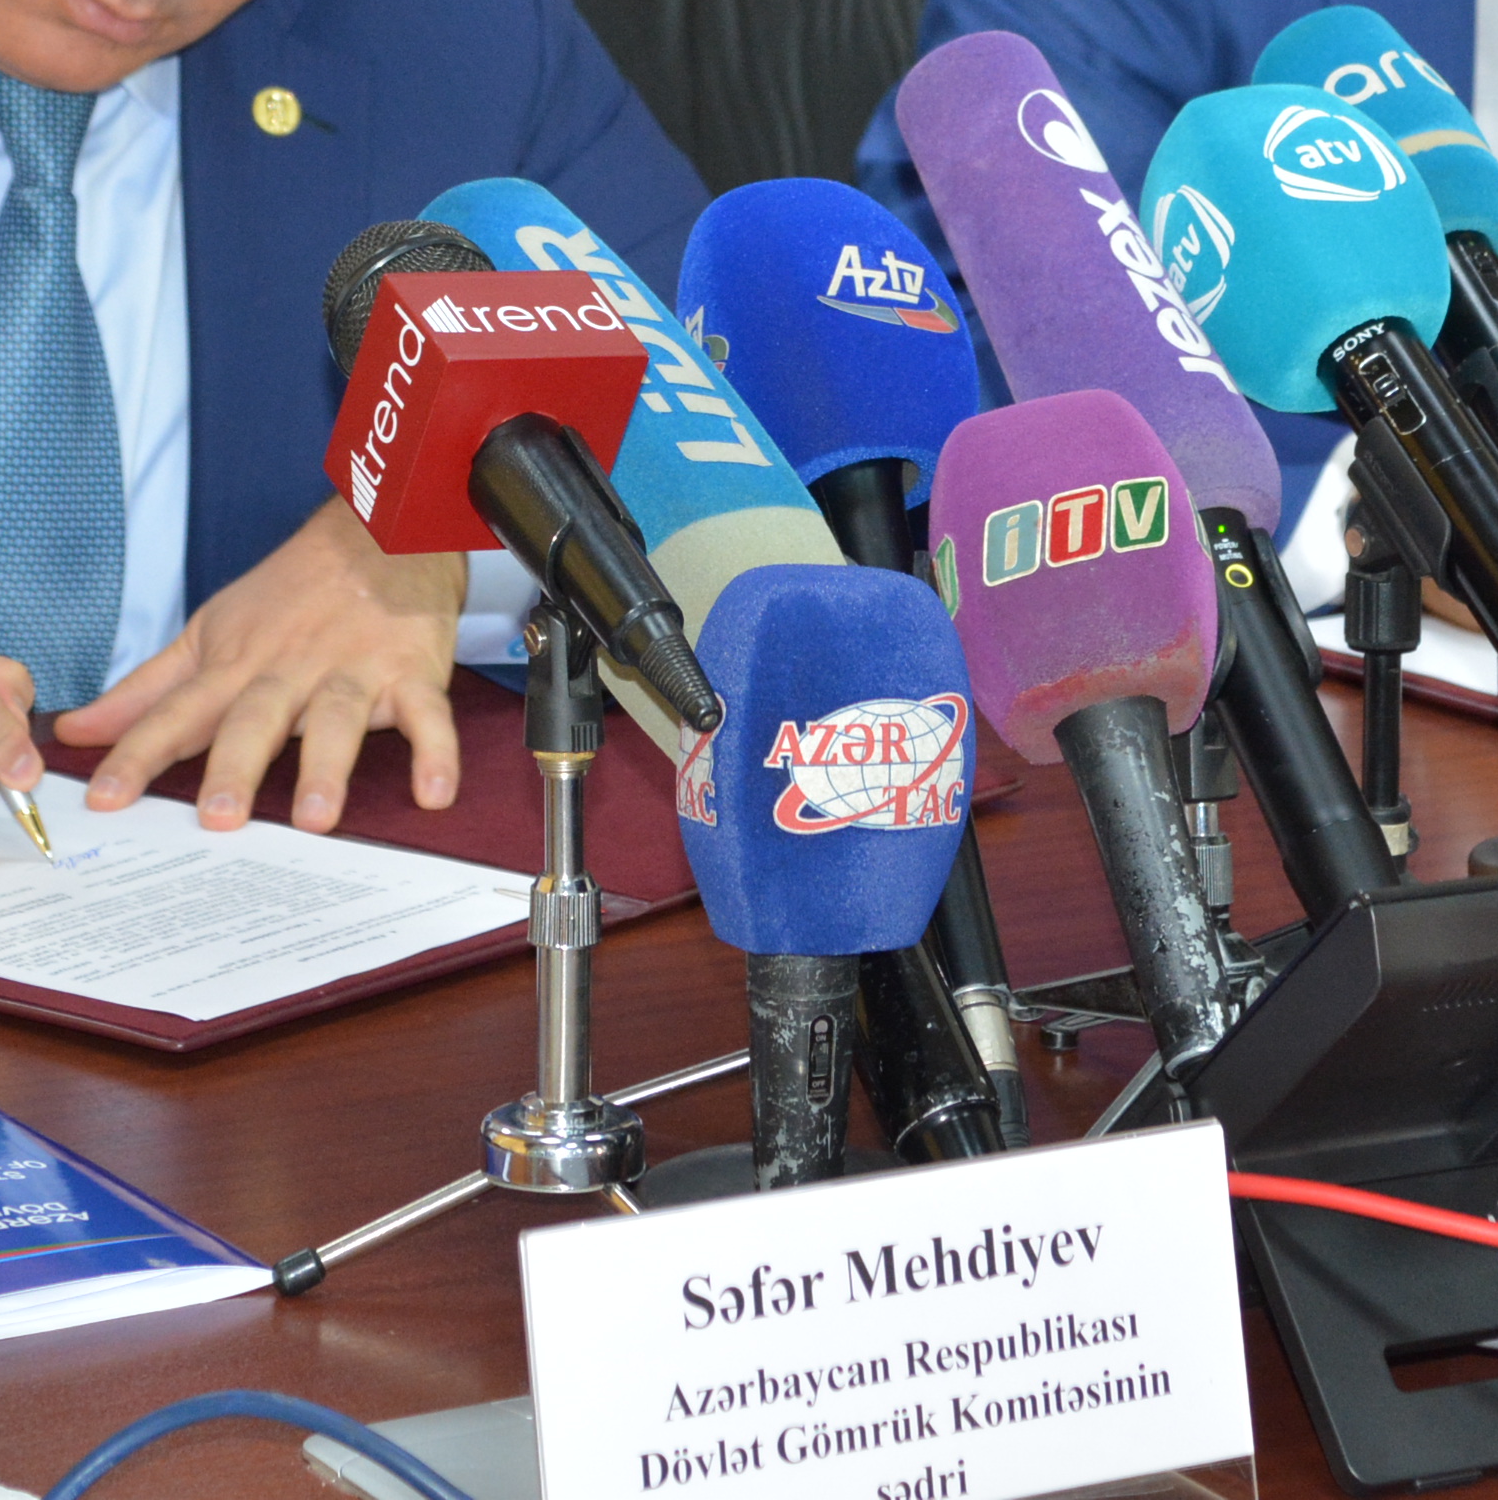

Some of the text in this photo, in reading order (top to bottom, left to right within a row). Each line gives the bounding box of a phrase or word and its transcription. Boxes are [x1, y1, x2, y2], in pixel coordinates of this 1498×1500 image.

[1295, 139, 1362, 169] atv
[1168, 223, 1201, 294] atv
[445, 291, 625, 333] trend
[1332, 322, 1385, 362] SONY
[350, 303, 426, 487] trend
[766, 722, 911, 766] AZƏR
[882, 781, 964, 826] TAC
[7, 1159, 48, 1170] OF
[681, 1223, 1104, 1332] Səfər Mehdiyev
[664, 1311, 1141, 1423] Azərbaycan Respublikası
[639, 1363, 1174, 1493] Dövlət Gömrük Komitəsinin
